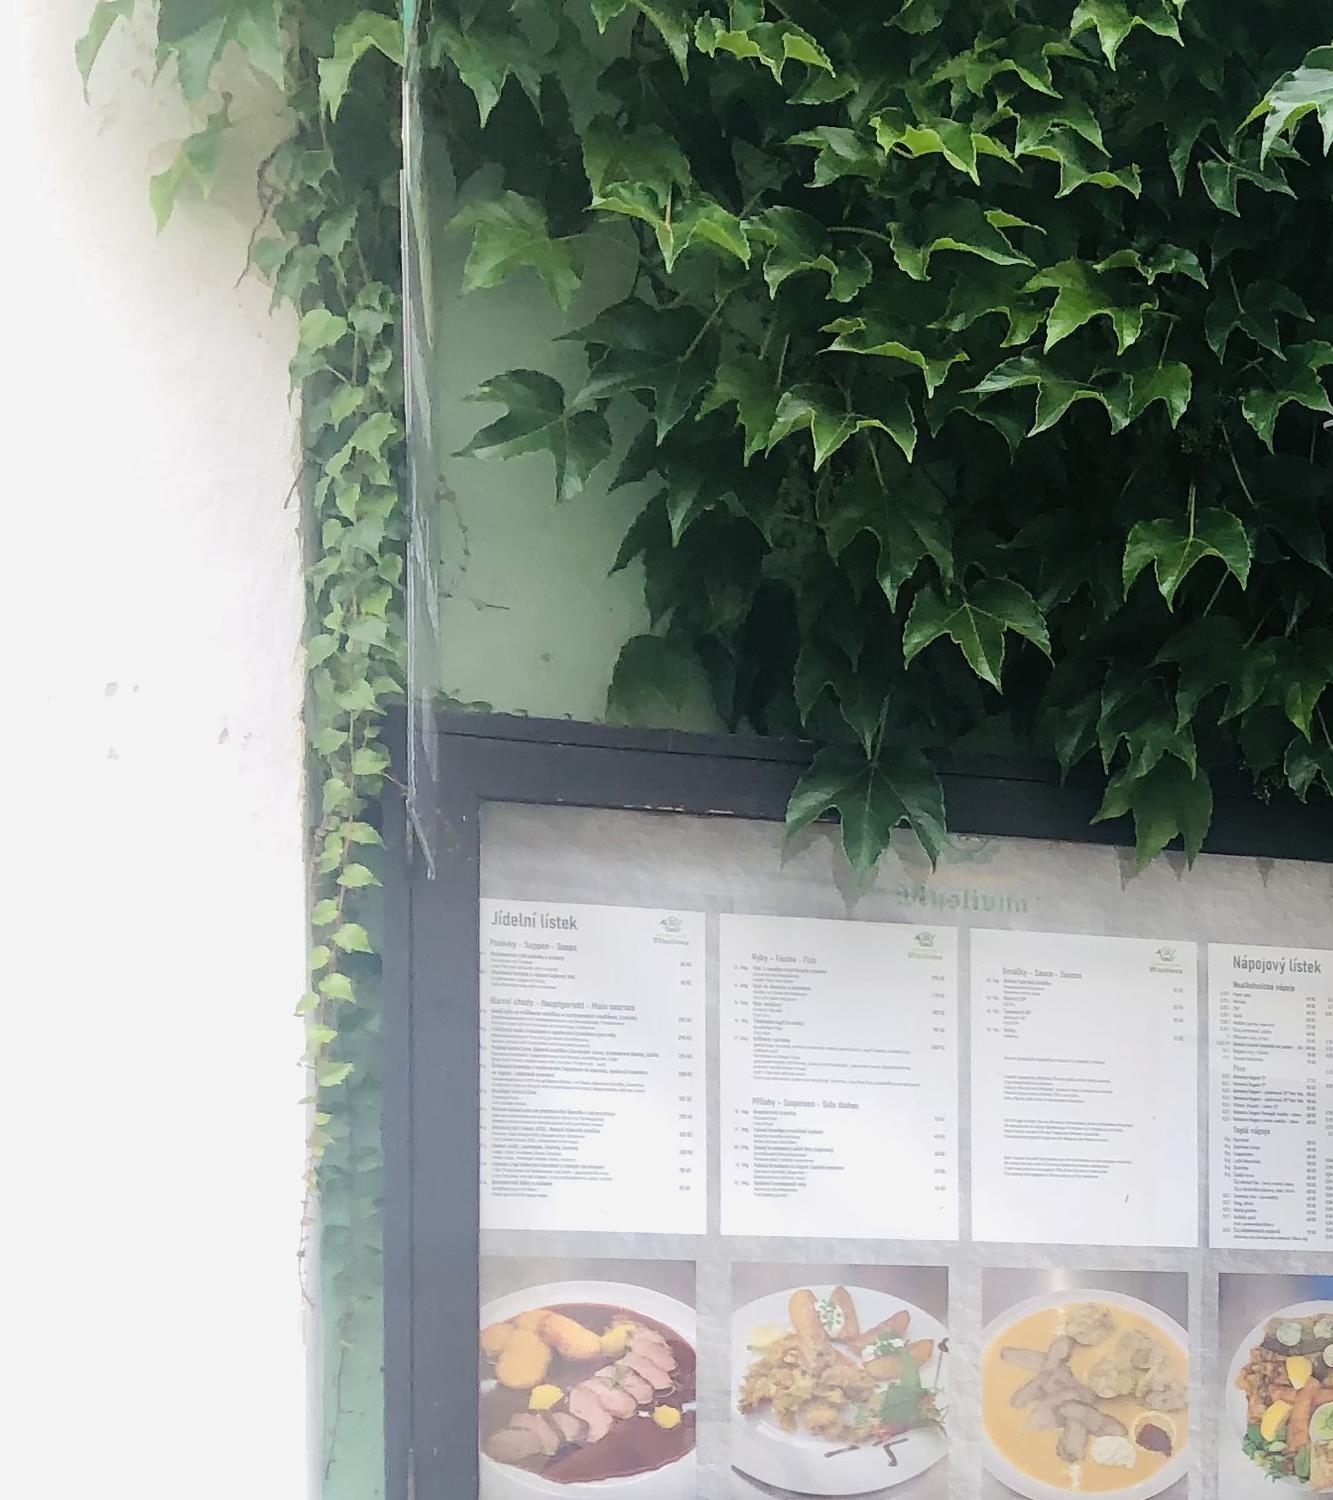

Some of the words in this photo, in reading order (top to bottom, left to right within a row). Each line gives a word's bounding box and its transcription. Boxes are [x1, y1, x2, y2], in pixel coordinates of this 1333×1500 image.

[490, 910, 536, 929] Jídelní
[540, 912, 578, 930] lístek
[1232, 954, 1286, 975] Nápojový
[1289, 957, 1322, 974] lístek
